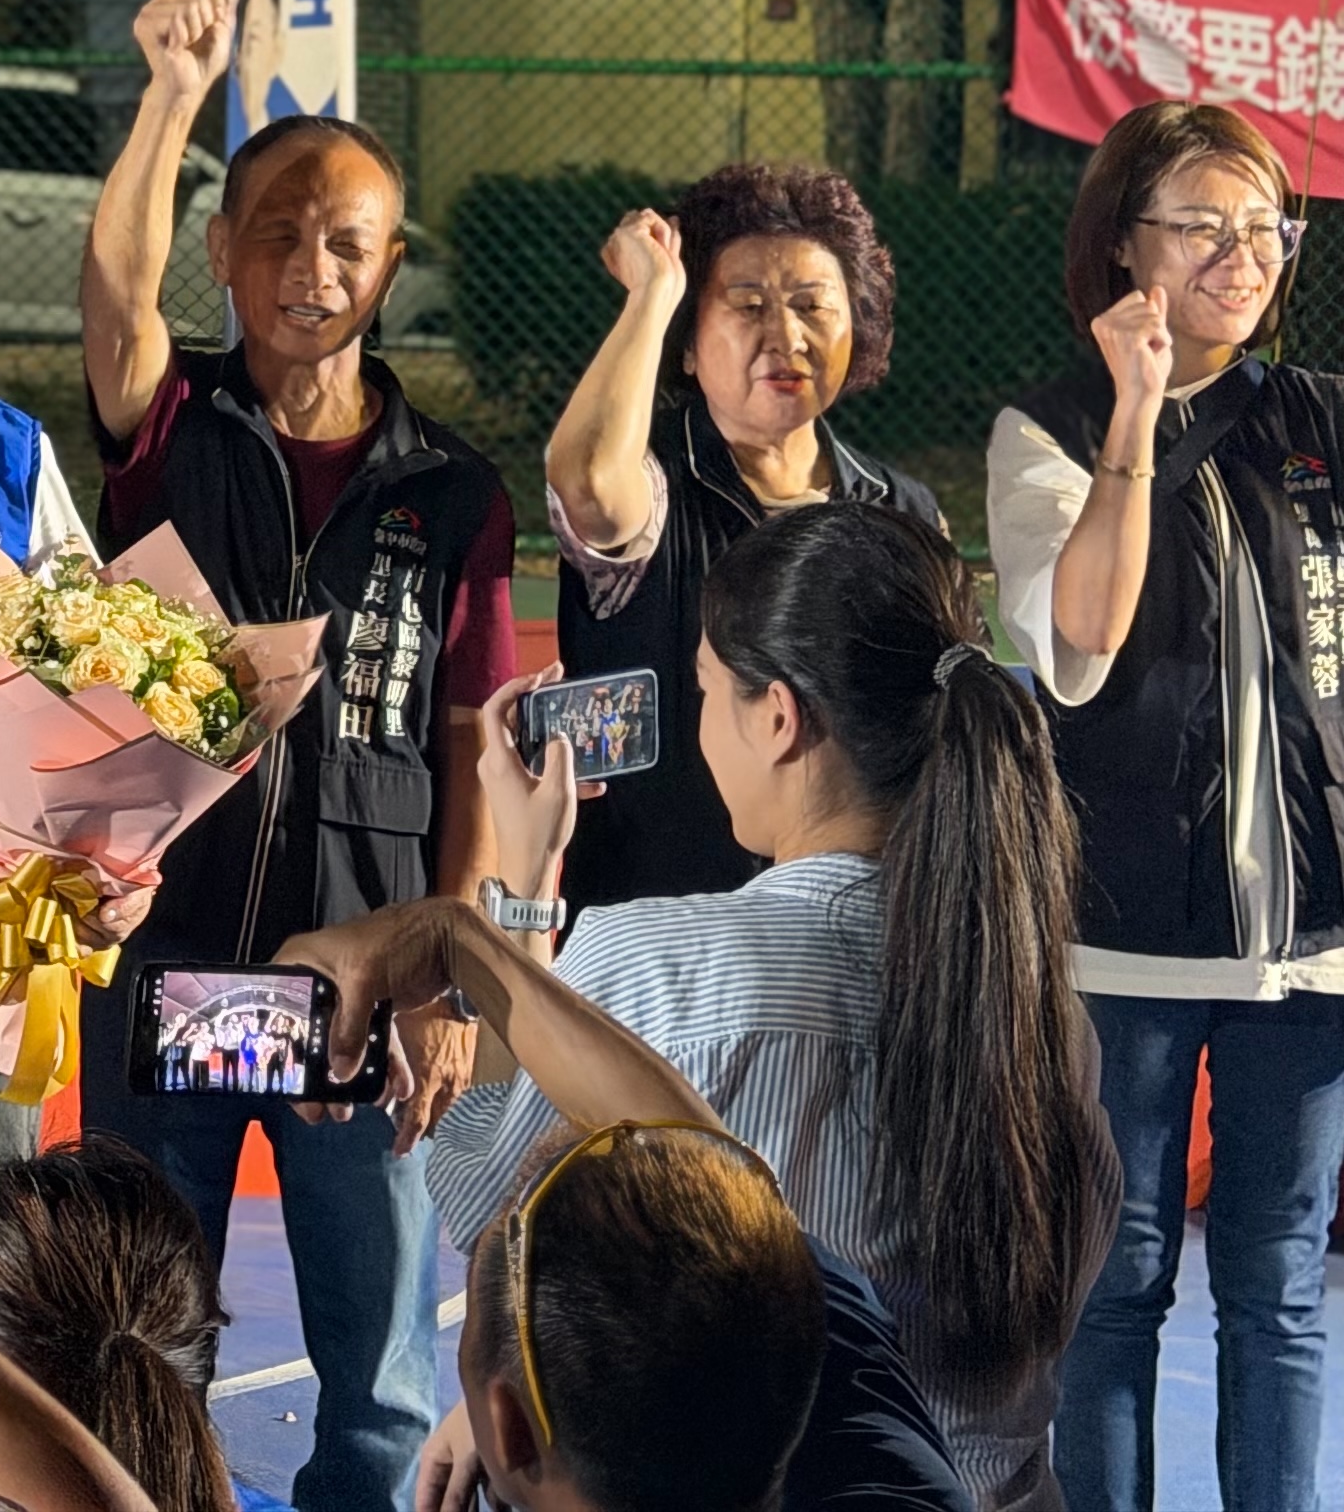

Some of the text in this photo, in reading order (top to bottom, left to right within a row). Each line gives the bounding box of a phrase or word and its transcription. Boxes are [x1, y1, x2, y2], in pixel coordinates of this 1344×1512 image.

[338, 610, 389, 744] 廖福田
[1300, 554, 1340, 700] 張家蓉
